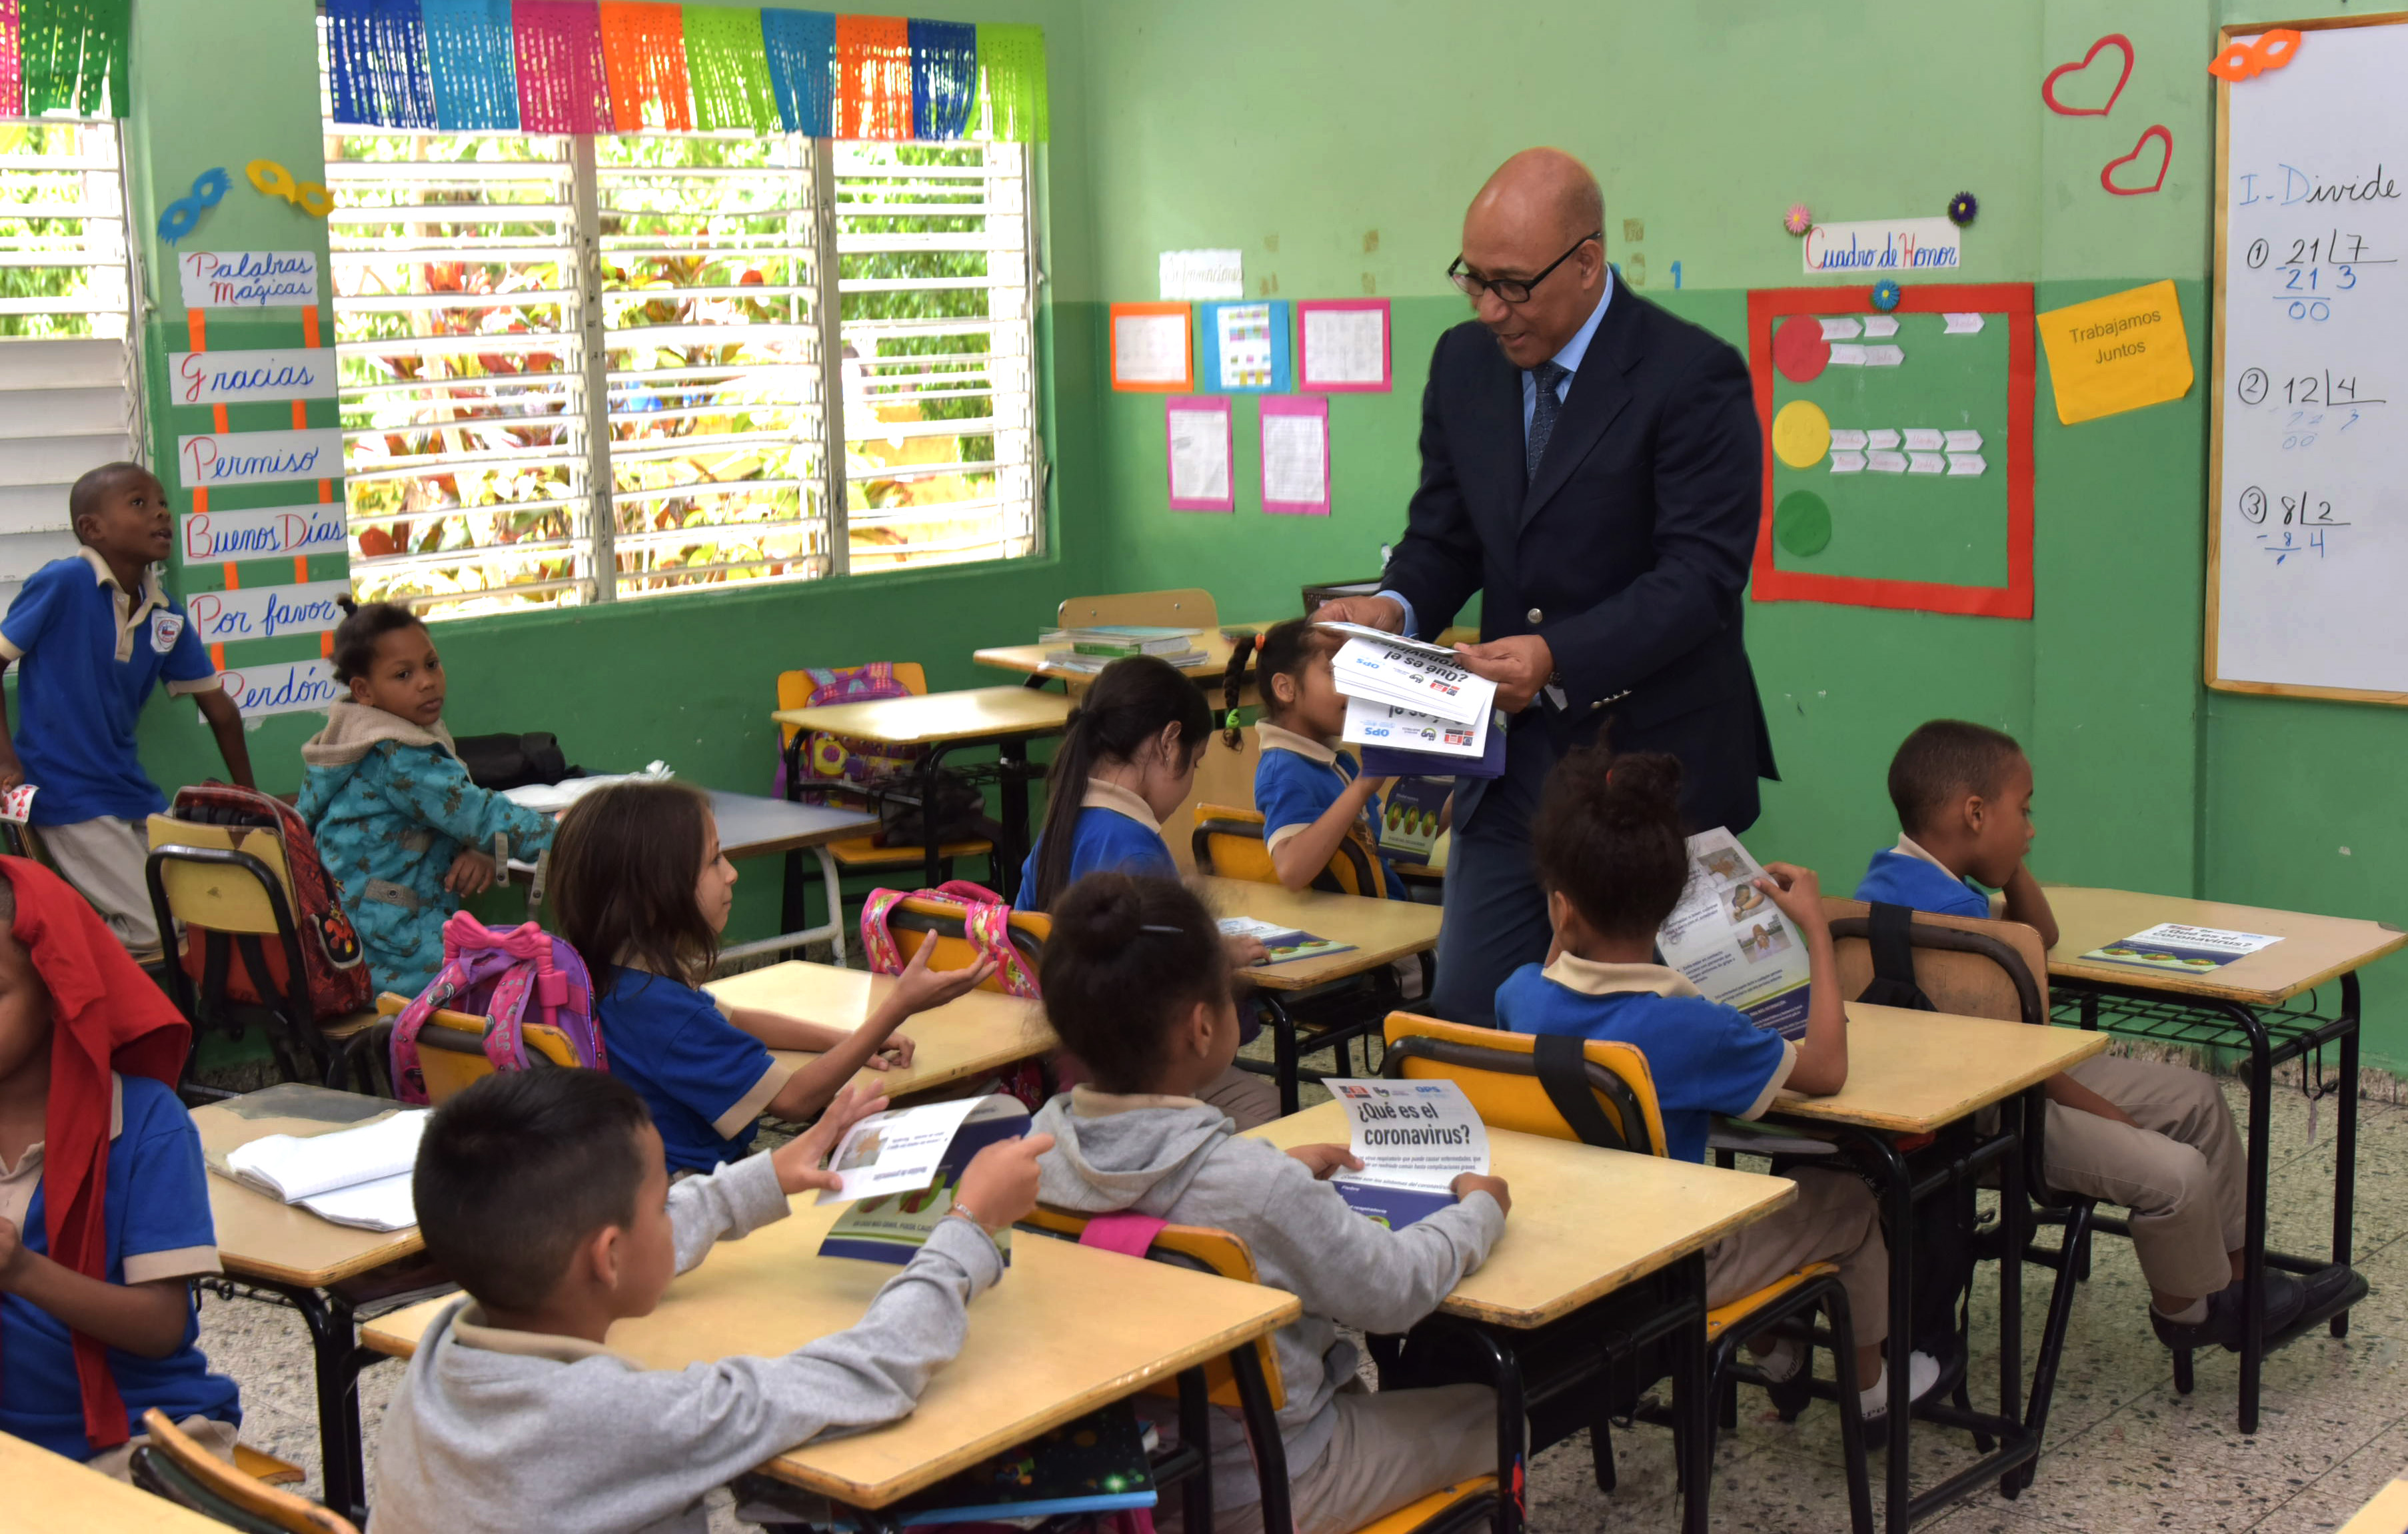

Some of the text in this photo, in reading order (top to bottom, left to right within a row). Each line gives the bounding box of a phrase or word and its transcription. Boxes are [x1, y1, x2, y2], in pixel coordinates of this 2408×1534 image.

[1806, 227, 1957, 269] Cuadro de Honor
[2285, 237, 2320, 265] 21
[2347, 233, 2370, 263] 7
[187, 251, 313, 280] Palabras
[2336, 265, 2357, 290] 3
[2069, 311, 2161, 344] Trabajamos
[2095, 341, 2146, 365] Juntos
[181, 353, 314, 402] Gracias
[2283, 377, 2319, 404] 12
[2337, 376, 2355, 399] 4
[184, 436, 319, 480] Permiso
[2281, 496, 2296, 525] 8
[2318, 501, 2333, 522] 2
[187, 512, 347, 558] Buenos Días
[2310, 528, 2324, 558] 4
[190, 594, 252, 640] Por
[261, 592, 335, 637] favor
[1356, 658, 1380, 670] OPS
[1384, 650, 1469, 684] ¿Qué es el
[1364, 727, 1390, 738] OPS
[1357, 1102, 1439, 1123] ¿Qué es el
[1364, 1124, 1470, 1146] coronavirus?
